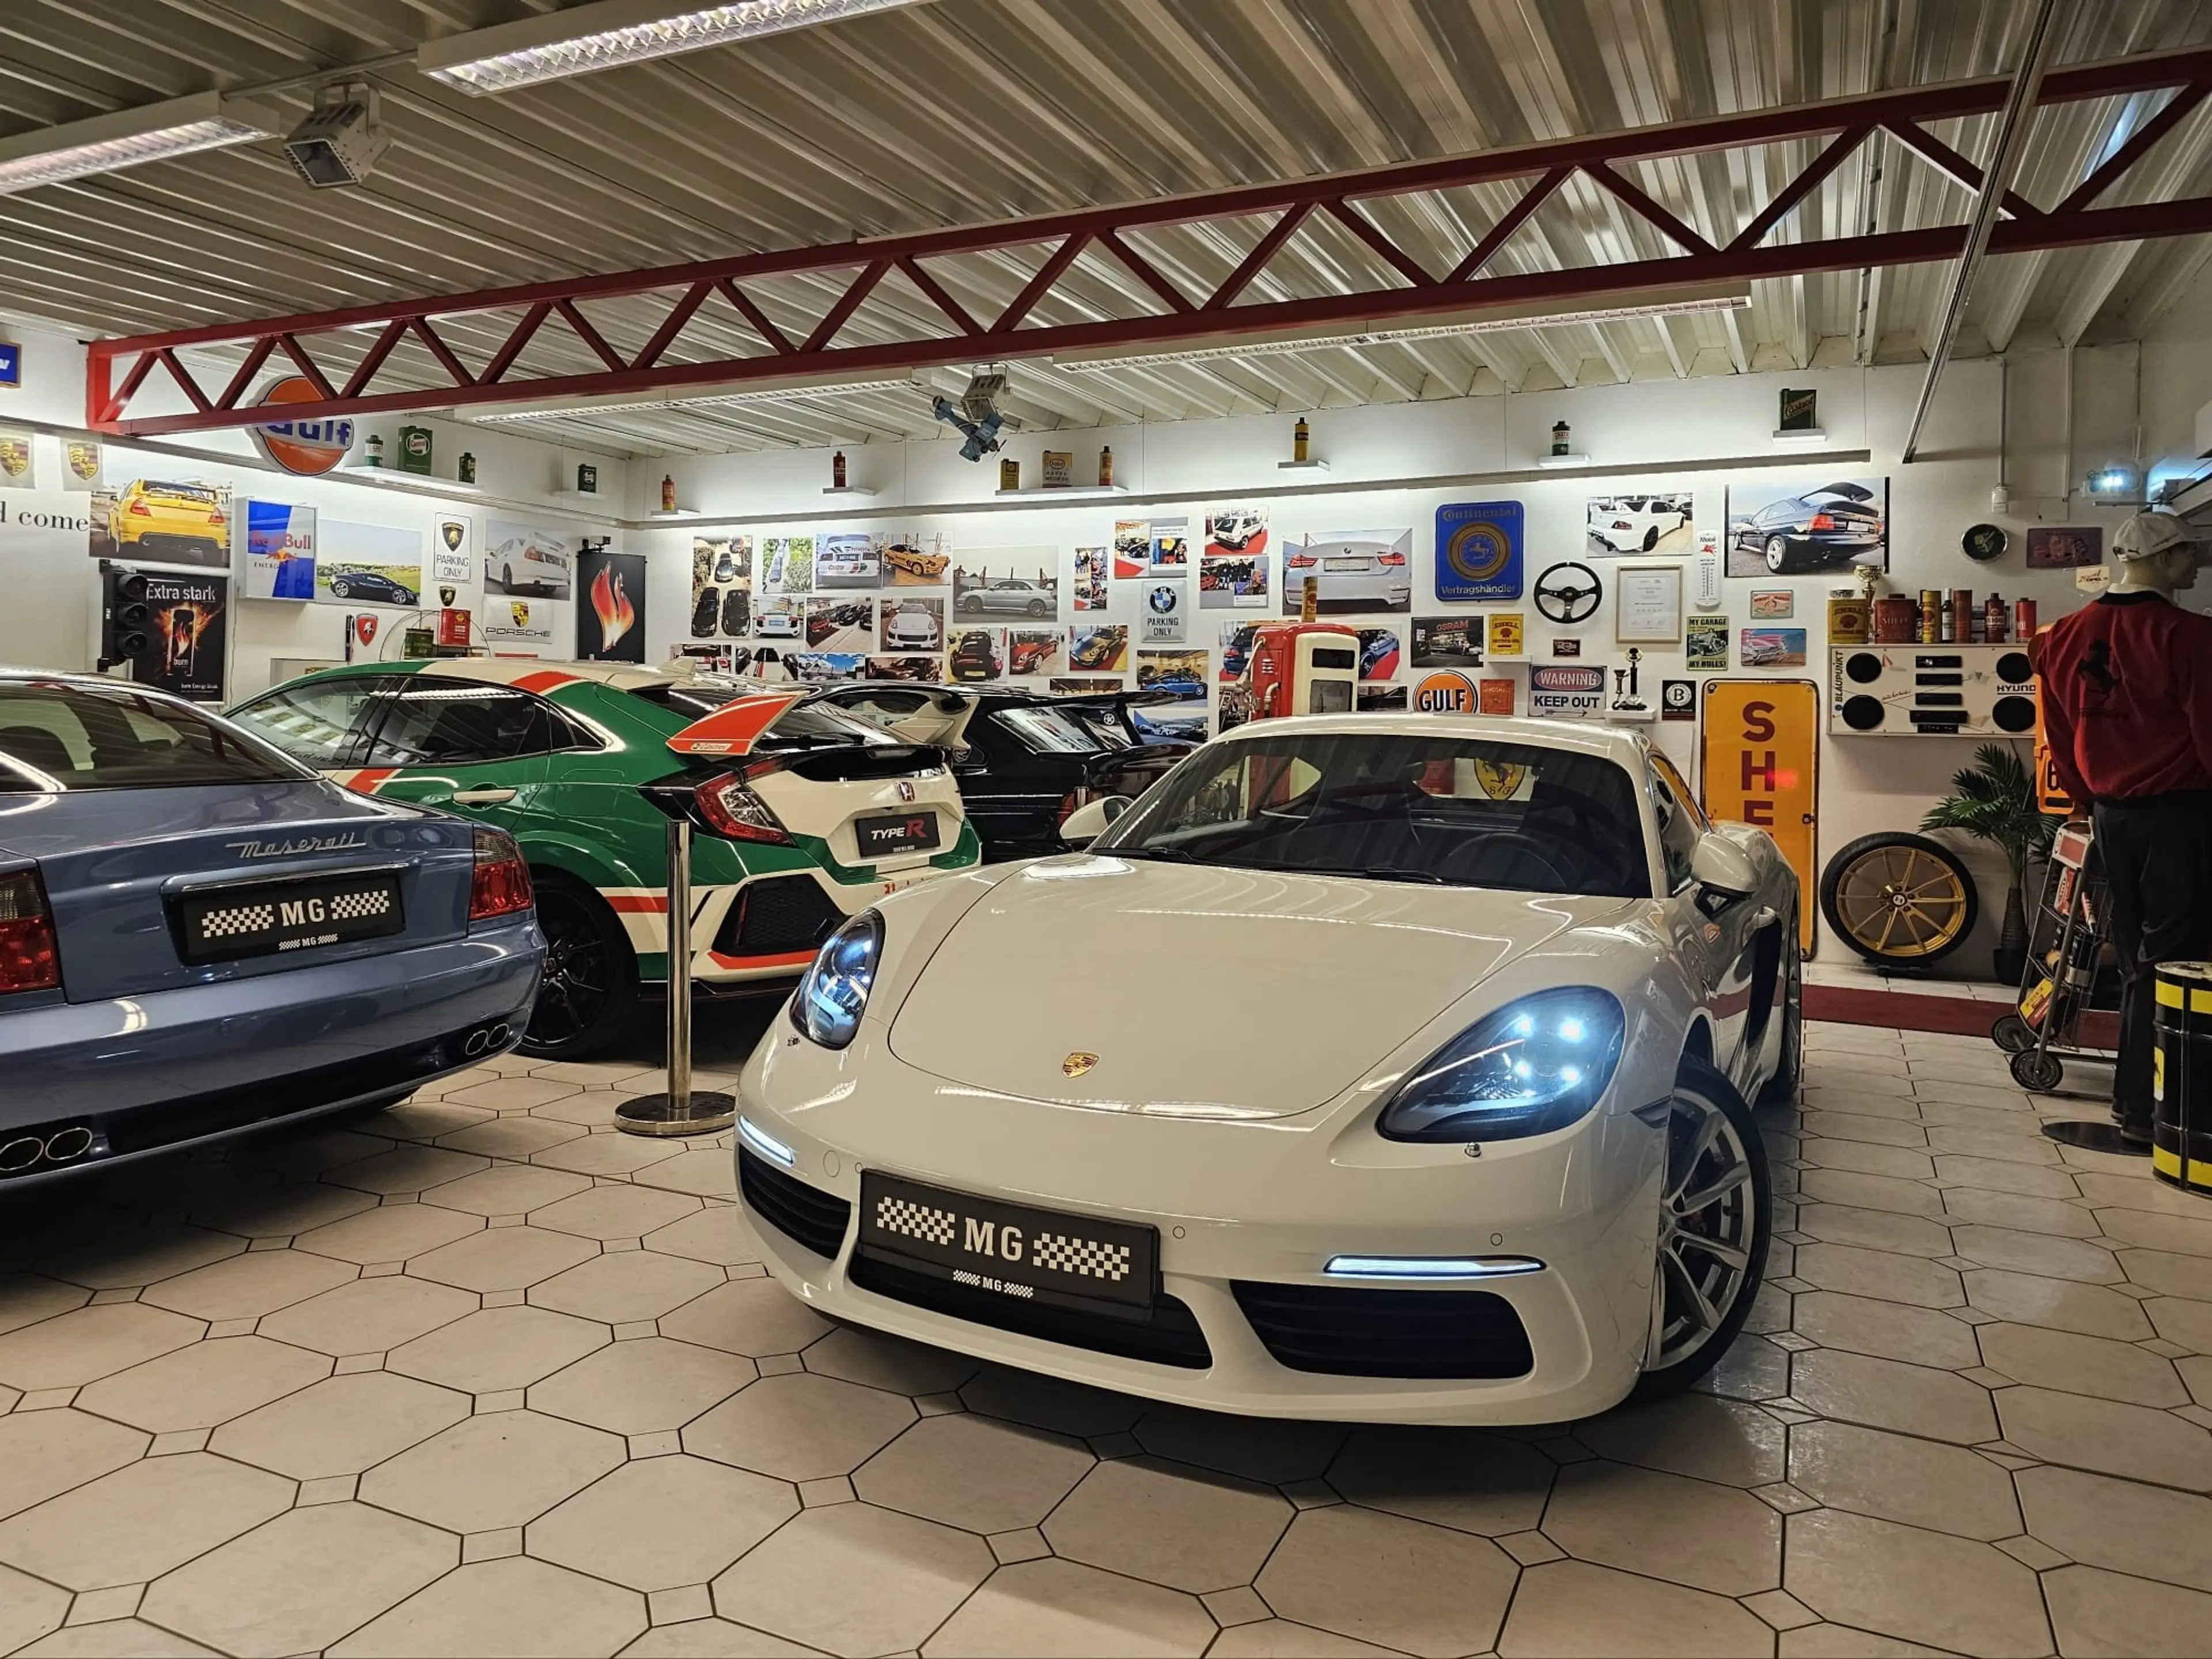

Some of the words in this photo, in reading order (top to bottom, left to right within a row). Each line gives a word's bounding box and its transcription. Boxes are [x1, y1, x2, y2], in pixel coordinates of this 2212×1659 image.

[18, 510, 90, 532] come
[1442, 506, 1517, 522] Continental
[285, 533, 311, 550] Bull
[436, 554, 469, 567] PARKING
[443, 567, 462, 577] ONLY
[146, 583, 180, 600] Extra
[183, 585, 216, 600] stark
[1441, 584, 1516, 595] Vertragshändler
[1147, 617, 1179, 626] PARKING
[1436, 619, 1469, 631] OSRAM
[486, 627, 551, 637] PORSCHE
[1153, 627, 1172, 636] ONLY
[1540, 672, 1597, 686] WARNING
[1835, 651, 1843, 702] BLAUPUNKT
[1419, 690, 1467, 711] GULF
[1673, 688, 1684, 701] B
[1534, 695, 1569, 708] KEEP
[1571, 696, 1600, 709] OUT
[871, 827, 906, 840] TYPE
[906, 819, 927, 838] R
[225, 832, 367, 859] Maserati
[279, 899, 325, 927] MG
[302, 937, 316, 946] MG
[964, 1217, 1023, 1262] MG
[983, 1276, 1002, 1291] MG
